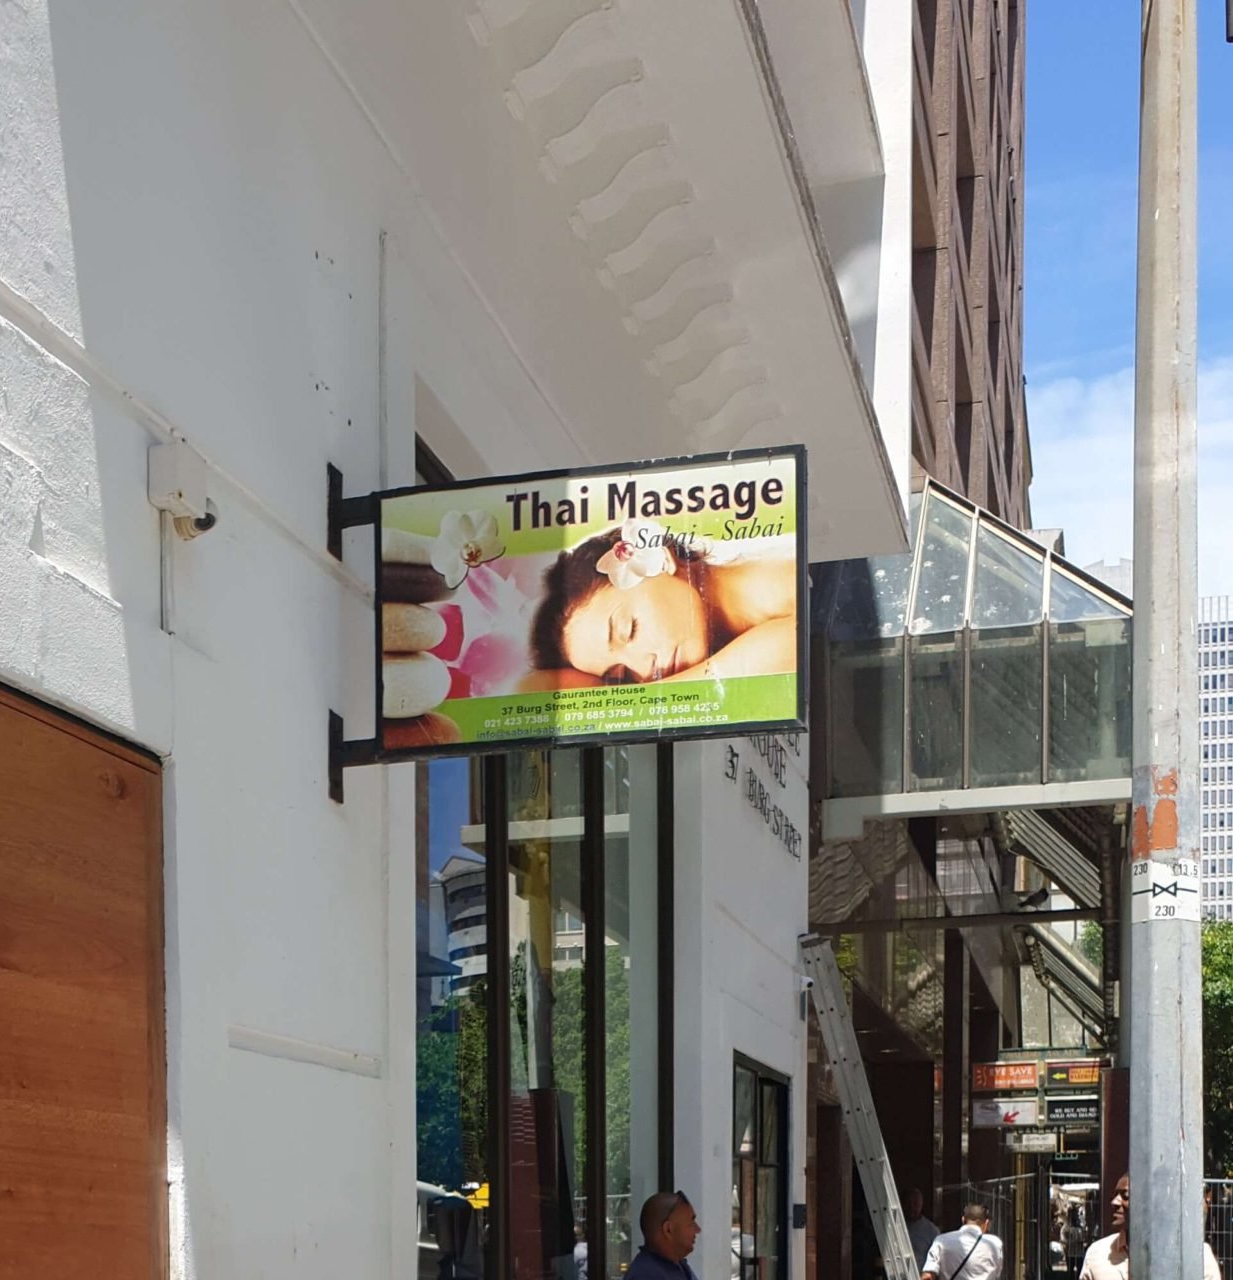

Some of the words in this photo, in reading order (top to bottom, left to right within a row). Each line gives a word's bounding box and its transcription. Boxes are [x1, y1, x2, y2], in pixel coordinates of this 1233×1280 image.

[506, 486, 589, 531] Thai
[607, 477, 784, 520] Massage
[635, 523, 697, 550] Sabai
[721, 515, 784, 542] Sabai
[553, 687, 607, 700] Gaurantee
[611, 686, 646, 696] House
[502, 707, 514, 716] 37
[517, 704, 542, 715] Burg
[545, 701, 579, 712] Street,
[583, 699, 603, 709] 2nd
[606, 697, 637, 707] Floor,
[639, 695, 668, 706] Cape
[671, 693, 700, 702] Town
[725, 744, 739, 784] 37
[1133, 862, 1148, 876] 230
[1154, 905, 1176, 917] 230
[1009, 1066, 1032, 1076] SAVE
